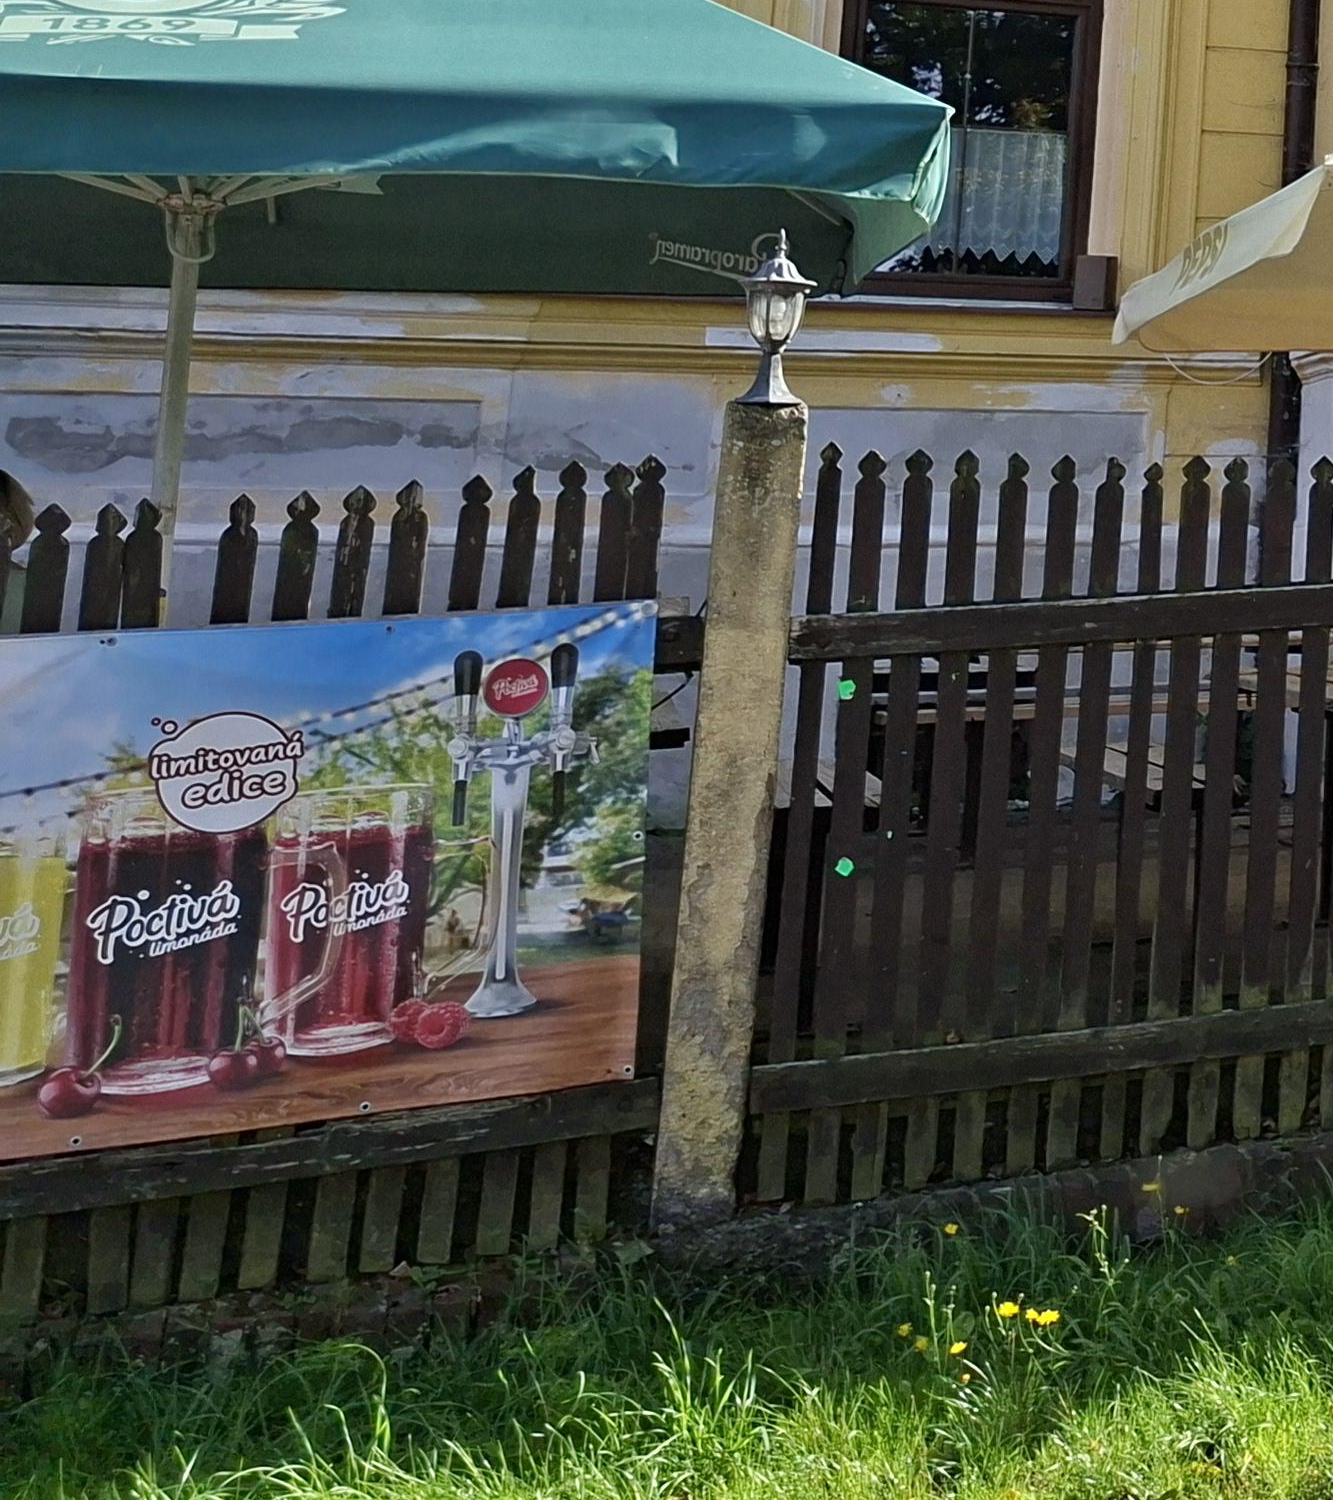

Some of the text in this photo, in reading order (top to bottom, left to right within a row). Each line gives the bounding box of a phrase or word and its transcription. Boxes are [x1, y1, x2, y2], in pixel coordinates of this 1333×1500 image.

[41, 17, 197, 32] 1869
[1169, 221, 1229, 297] PEPSI
[150, 730, 303, 781] limitovaná
[182, 769, 287, 809] edice
[86, 880, 240, 964] Poctivá
[280, 869, 409, 943] Poctivá
[333, 906, 408, 937] limonáda
[149, 921, 238, 957] limonáda
